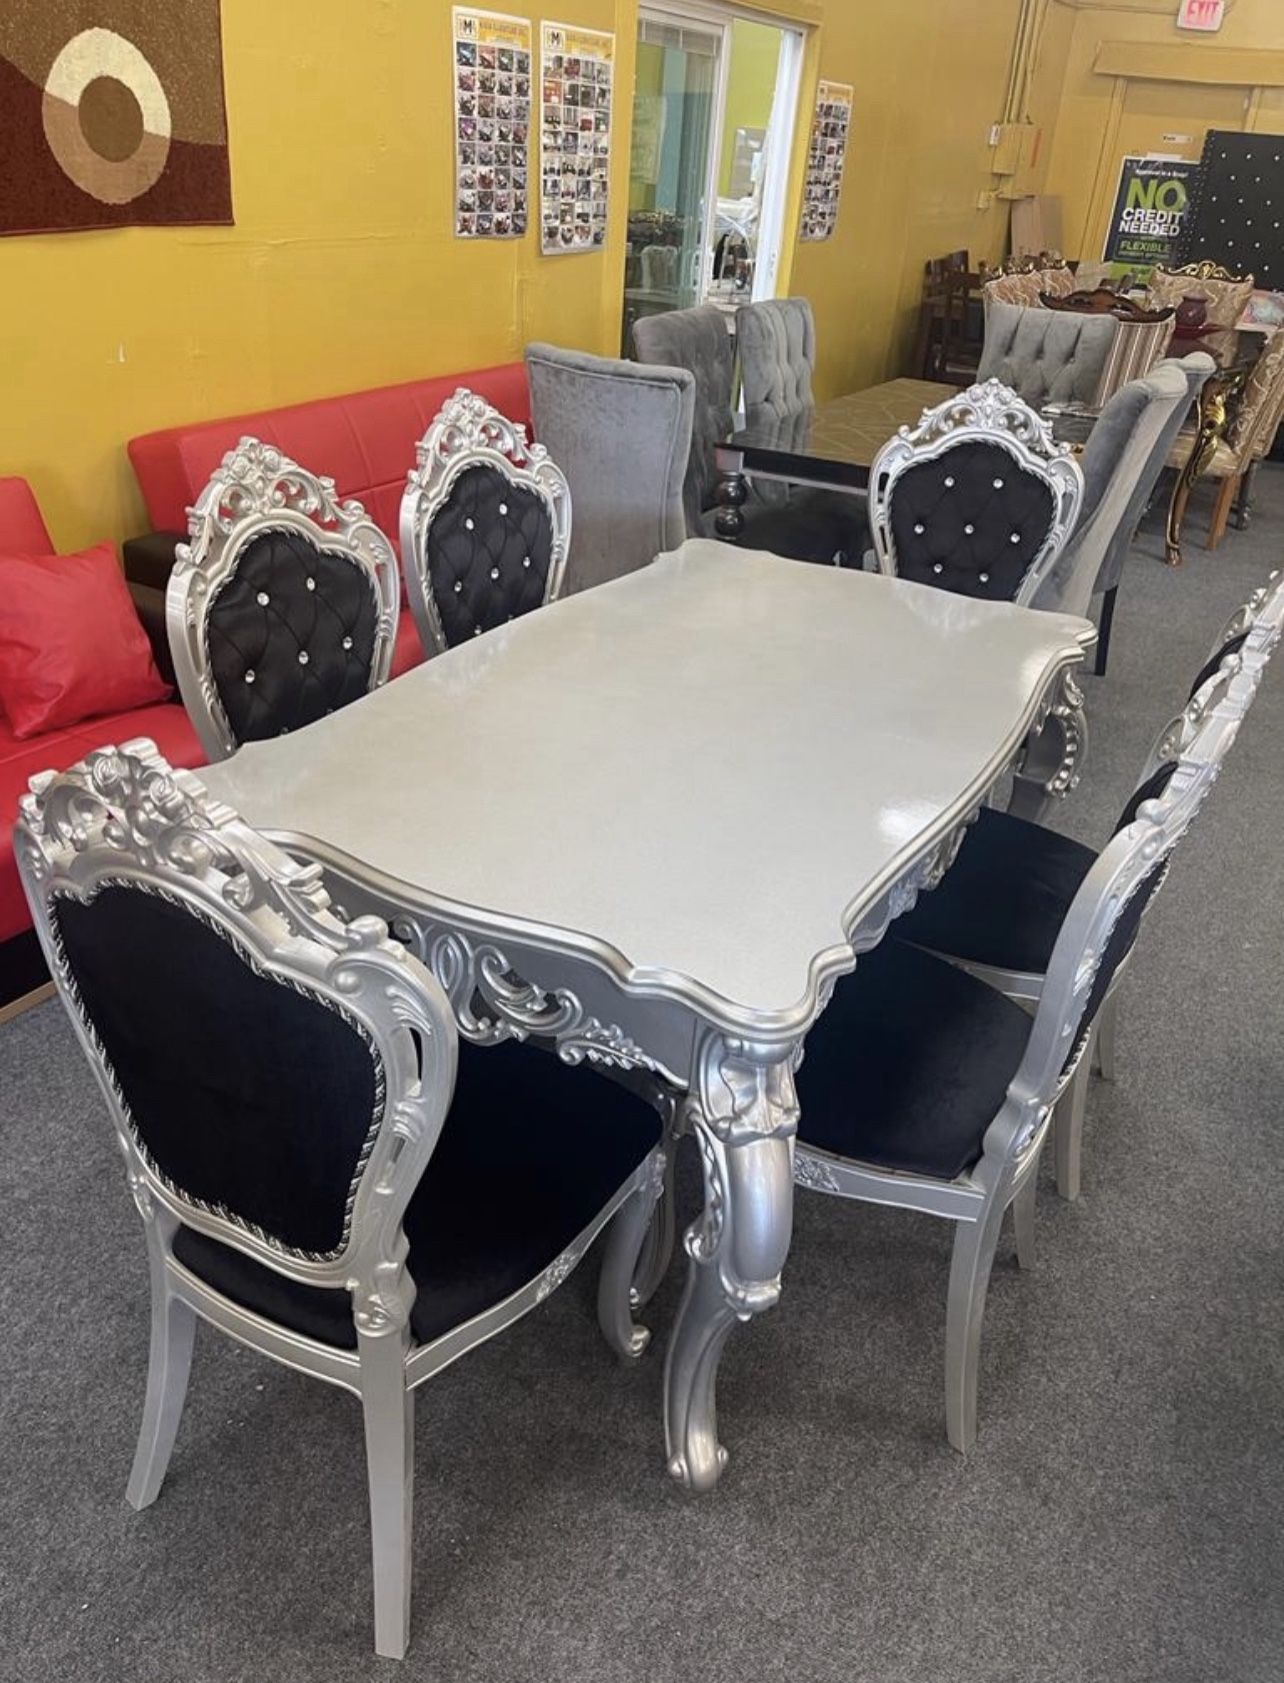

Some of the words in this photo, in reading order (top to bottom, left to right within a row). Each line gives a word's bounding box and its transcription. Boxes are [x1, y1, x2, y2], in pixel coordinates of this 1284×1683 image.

[1184, 0, 1219, 23] EXIT
[1126, 178, 1187, 211] NO
[1122, 207, 1184, 224] CREDIT
[1118, 220, 1181, 237] NEEDED
[1120, 240, 1172, 253] FLEXIBLE
